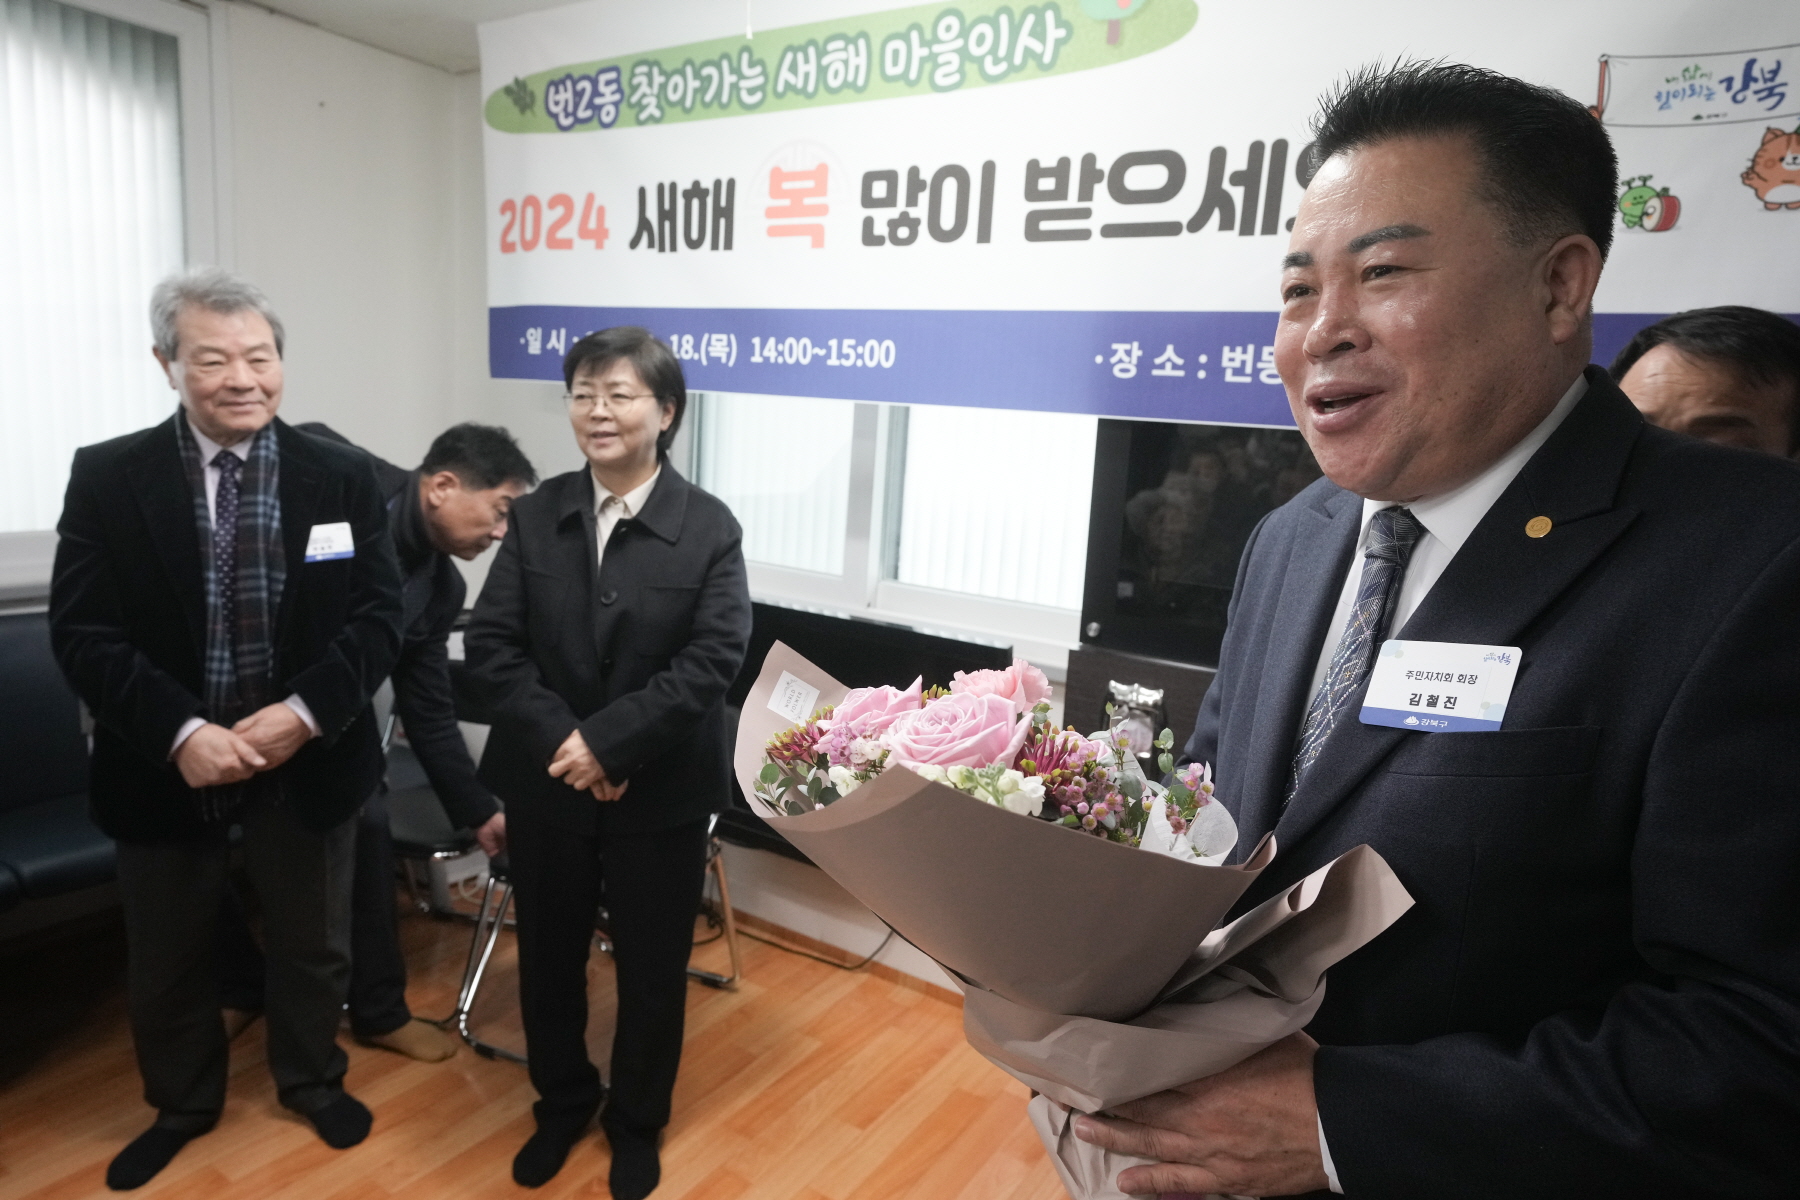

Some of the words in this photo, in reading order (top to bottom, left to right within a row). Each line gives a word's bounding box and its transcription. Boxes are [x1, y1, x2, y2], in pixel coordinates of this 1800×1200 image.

[546, 69, 624, 128] 번2동
[628, 50, 767, 122] 찾아가는
[775, 36, 869, 94] 새해
[883, 8, 1068, 87] 마을인사
[1718, 57, 1789, 112] 강북
[499, 191, 610, 254] 2024
[629, 177, 736, 253] 새해
[763, 162, 831, 250] 복
[859, 159, 996, 247] 많이
[1023, 138, 1318, 244] 받으세
[750, 336, 896, 369] 14:00~15:00
[1405, 670, 1454, 683] 주민자치회
[1456, 673, 1478, 685] 회장
[1420, 718, 1448, 728] 강북구
